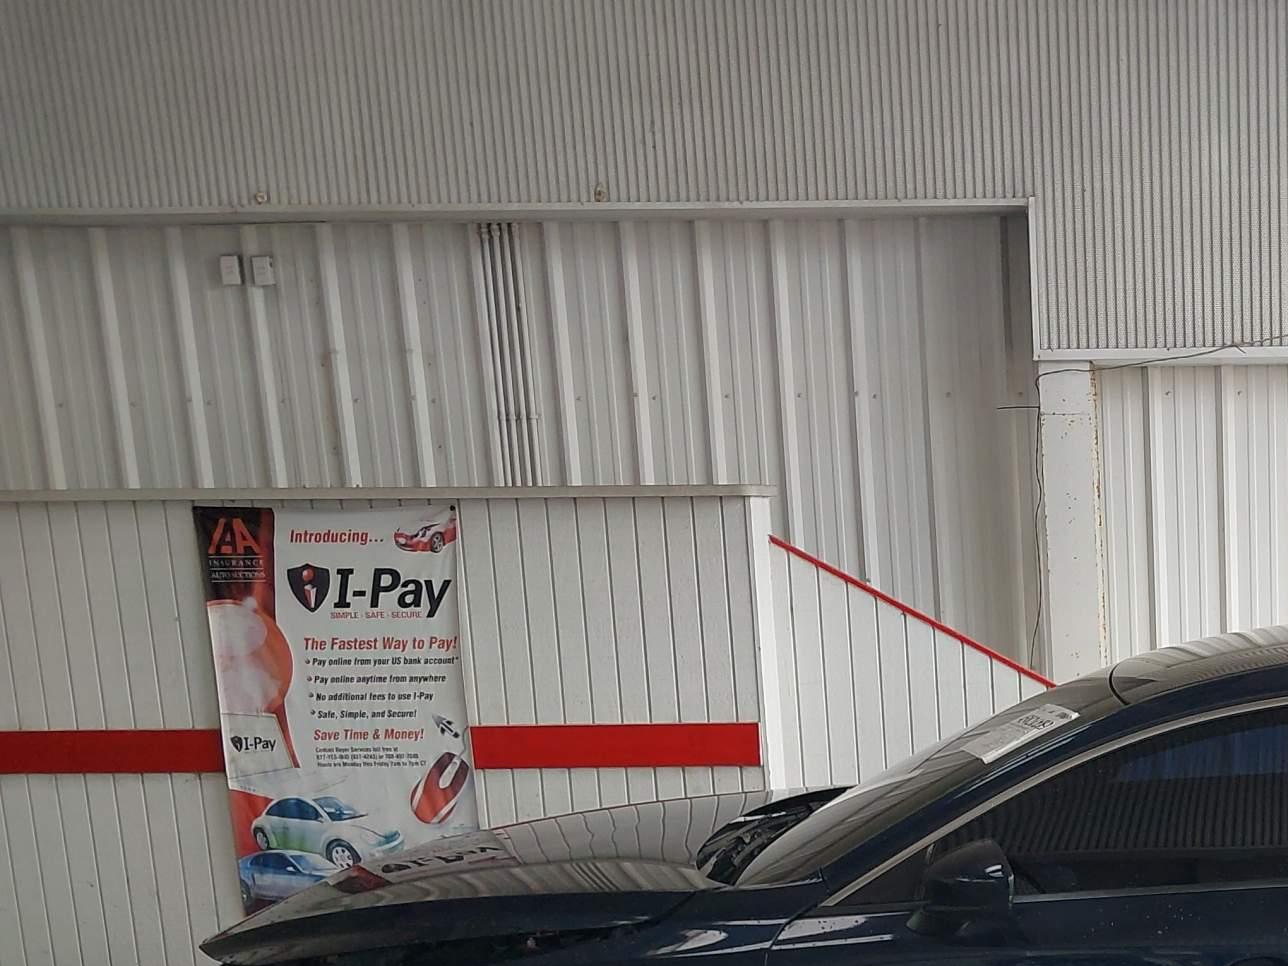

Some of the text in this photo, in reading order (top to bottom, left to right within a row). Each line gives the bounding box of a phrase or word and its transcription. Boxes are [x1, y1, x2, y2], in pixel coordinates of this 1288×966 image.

[289, 529, 384, 546] Introducing...
[208, 559, 265, 568] INSURANCE
[333, 567, 452, 618] I-Pay
[330, 611, 422, 619] SIMPLE SAFE SECURE
[304, 635, 458, 653] The Fastest Way to Pay!
[312, 658, 326, 667] Pay
[328, 657, 352, 666] online
[354, 657, 372, 666] from
[372, 658, 390, 667] your
[391, 656, 402, 665] US
[403, 656, 422, 665] bank
[314, 674, 447, 685] Pay online anytime from anywhere
[316, 691, 434, 702] No additional fees to use I-Pay
[317, 709, 417, 720] Safe, Simple, and Secure!
[313, 728, 425, 742] Save Time & Money!
[244, 736, 277, 752] I-Pay
